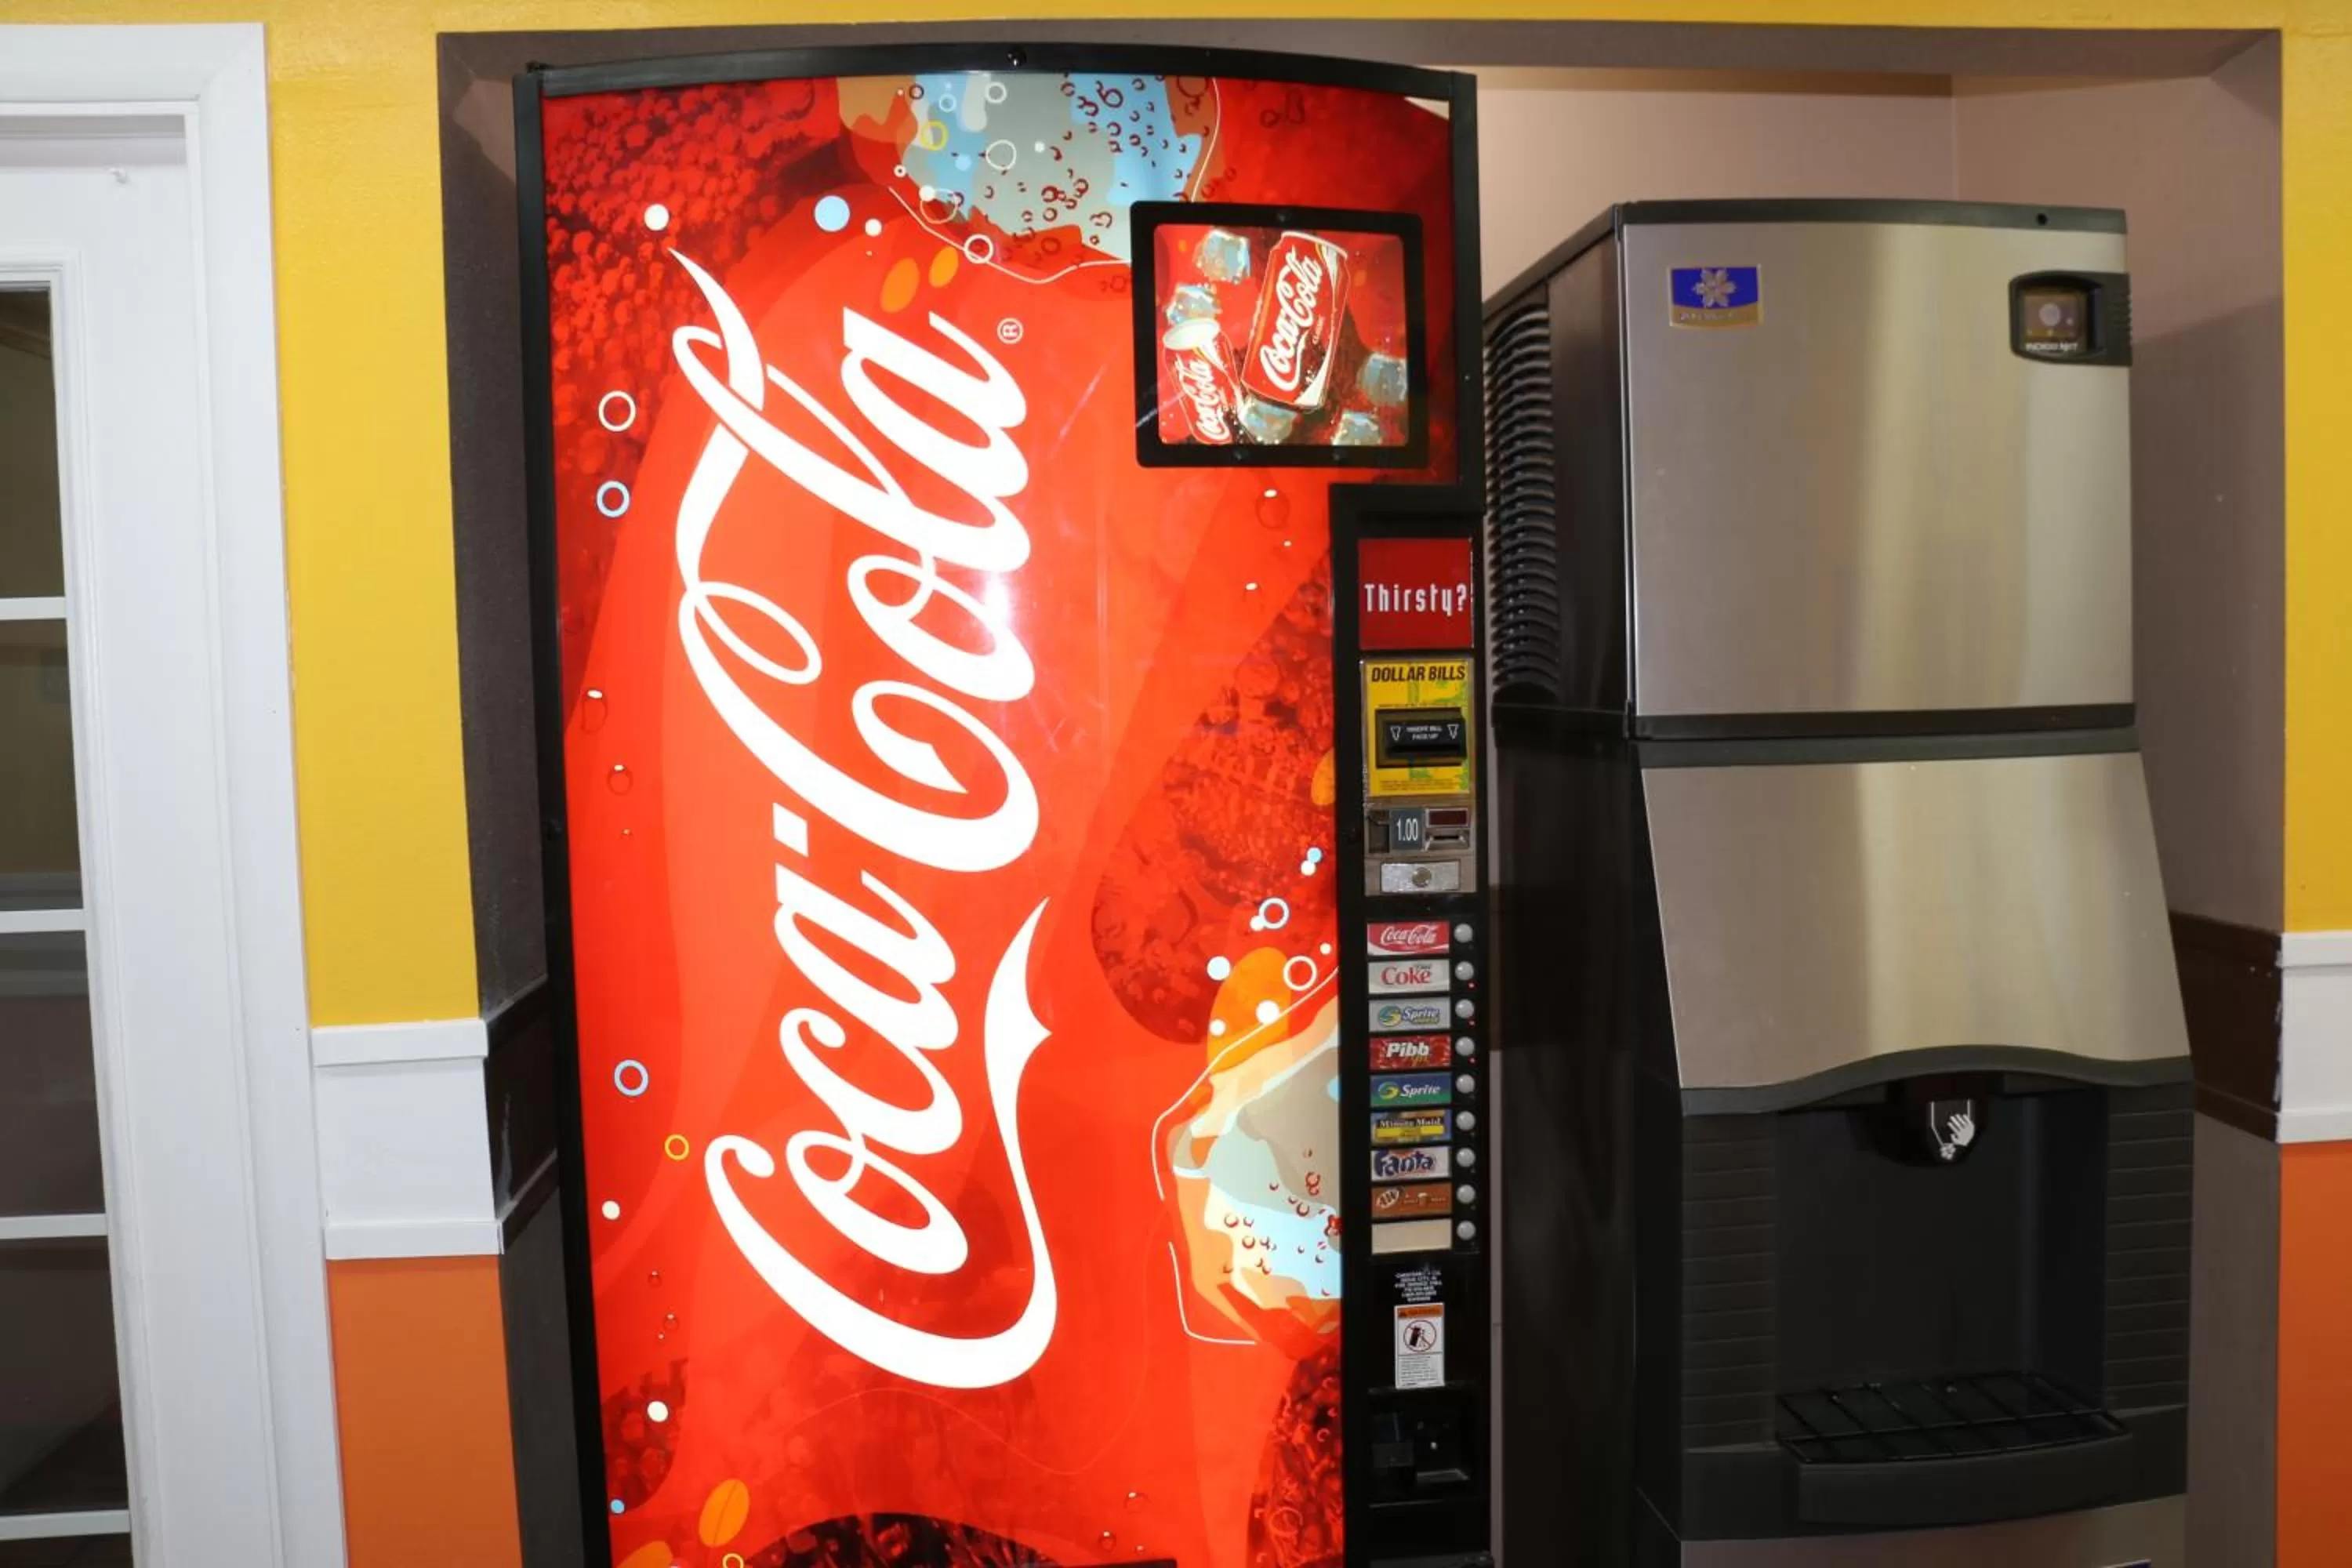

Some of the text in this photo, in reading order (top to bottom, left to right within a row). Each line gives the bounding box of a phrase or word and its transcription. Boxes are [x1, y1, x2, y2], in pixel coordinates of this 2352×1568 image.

[1364, 583, 1468, 617] Thirsty?
[1372, 665, 1465, 682] DOLLAR BILLS
[668, 246, 1058, 1389] Coca-Cola
[1396, 818, 1419, 842] 1.00
[1381, 966, 1432, 985] Coke
[1402, 1007, 1441, 1022] Sprite
[1385, 1041, 1431, 1058] Pibb
[1400, 1083, 1442, 1098] Sprite
